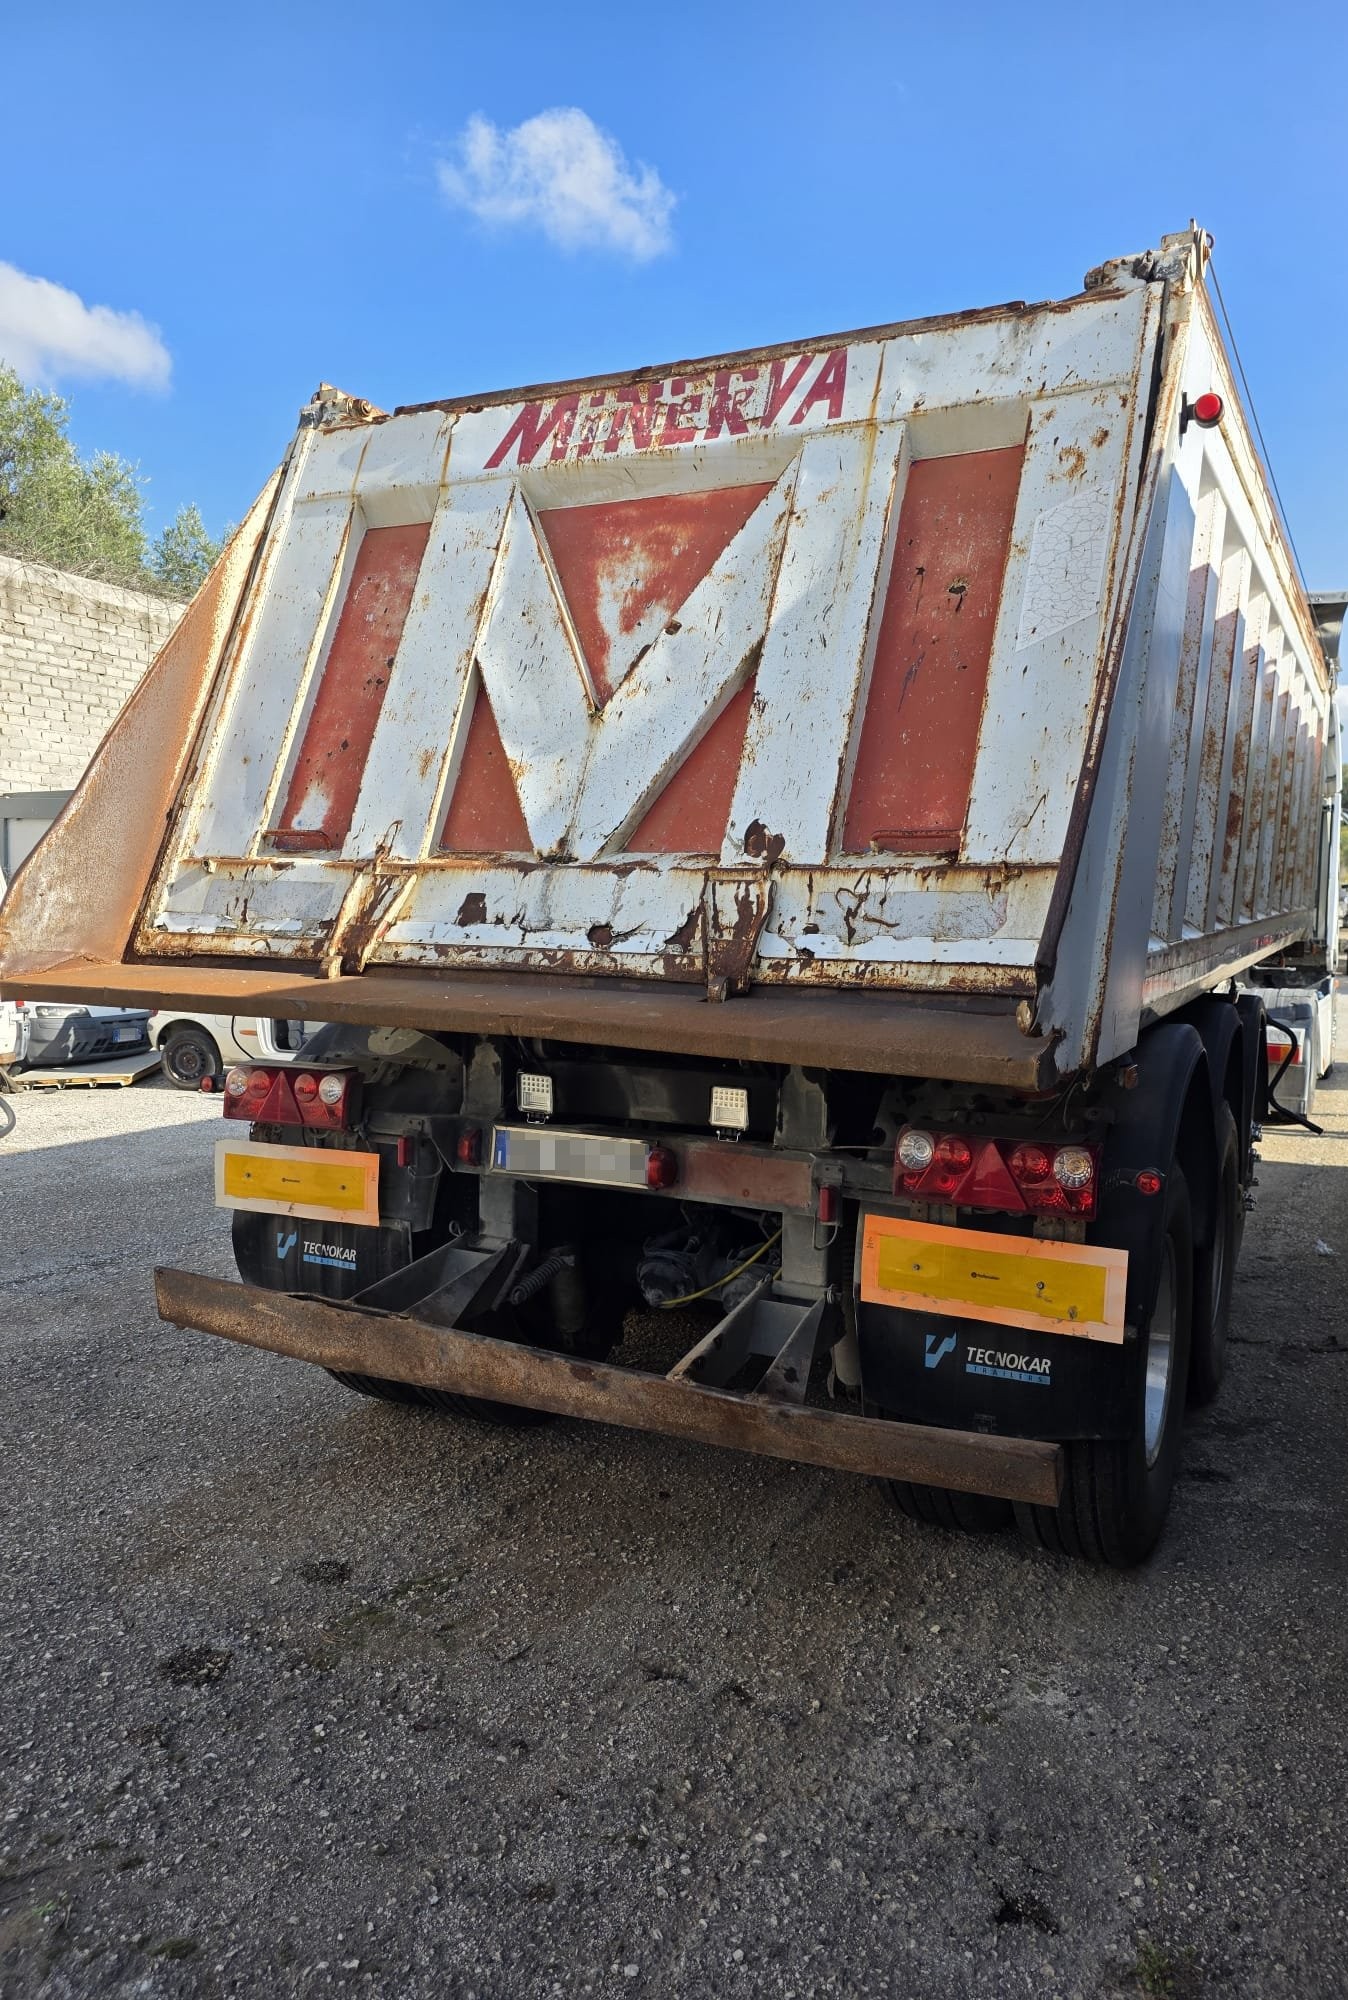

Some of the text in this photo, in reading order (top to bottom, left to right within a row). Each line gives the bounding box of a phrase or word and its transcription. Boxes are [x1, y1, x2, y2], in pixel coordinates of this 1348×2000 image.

[303, 1241, 356, 1261] TECNOKAR
[967, 1346, 1051, 1374] TECNOKAR
[973, 1365, 1044, 1382] TRAILERS
